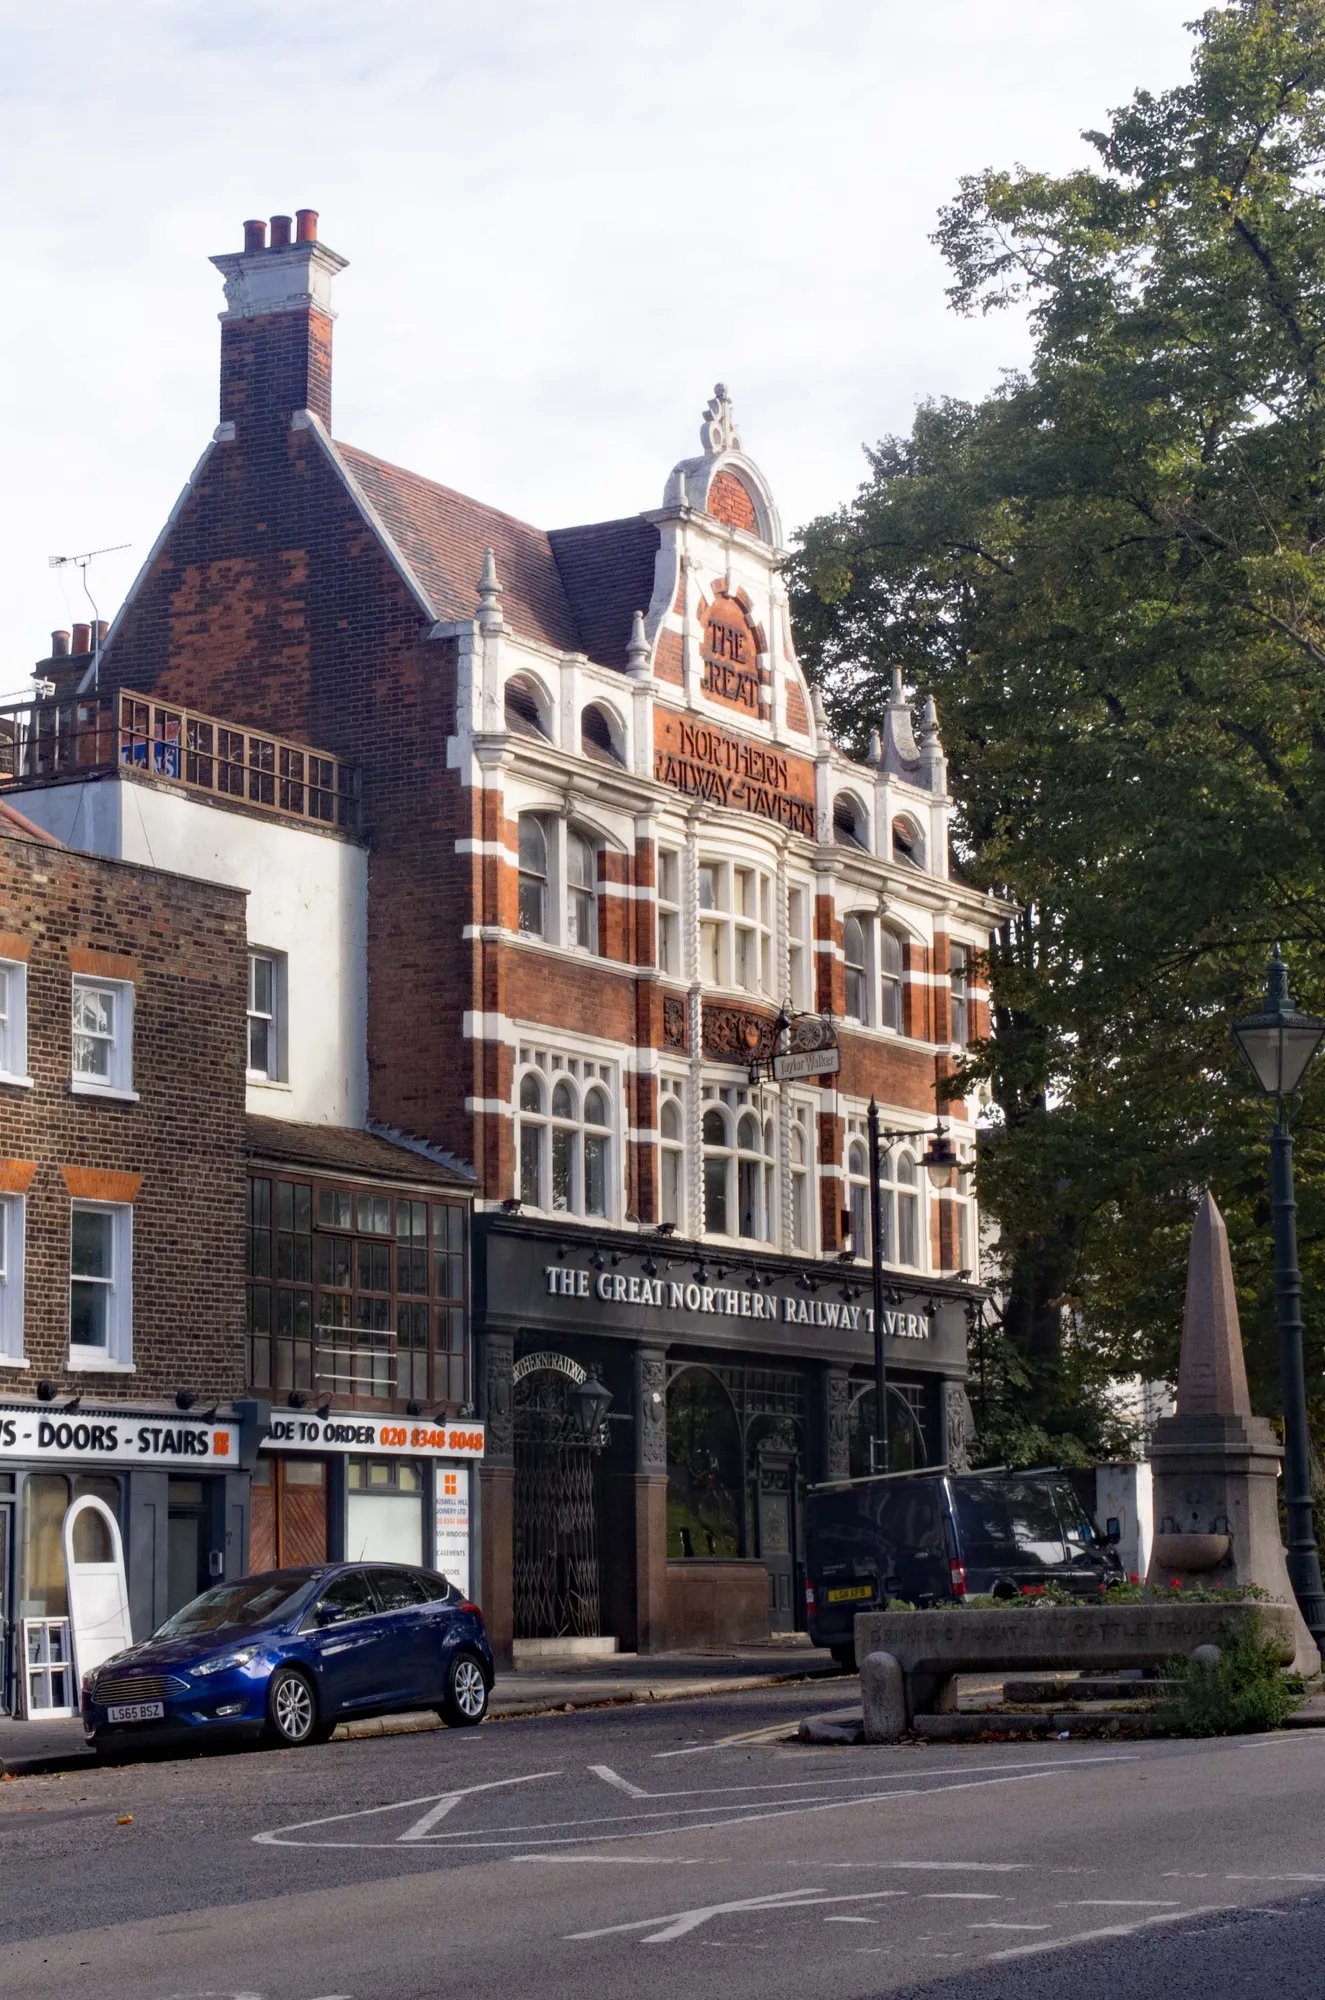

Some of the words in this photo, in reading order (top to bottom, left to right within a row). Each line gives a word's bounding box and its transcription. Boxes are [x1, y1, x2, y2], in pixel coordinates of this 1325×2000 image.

[708, 620, 746, 665] THE
[679, 721, 788, 790] NORTHERN
[779, 1057, 804, 1075] Taylor
[804, 1053, 834, 1072] Walker
[545, 1266, 590, 1297] THE
[597, 1273, 664, 1307] GREAT
[668, 1281, 777, 1320] NORTHERN
[784, 1297, 860, 1331] RAILWAY
[551, 1352, 587, 1385] RAILWA
[0, 1420, 16, 1447] S
[38, 1422, 118, 1451] DOORS
[138, 1427, 209, 1455] STAIRS
[265, 1421, 295, 1441] ADE
[300, 1422, 319, 1442] TO
[323, 1423, 375, 1444] ORDER
[380, 1426, 407, 1446] 020
[411, 1428, 446, 1449] 8348
[449, 1430, 483, 1451] 8048
[446, 1530, 469, 1538] WINDOWS
[437, 1549, 466, 1557] CASEMENTS
[442, 1568, 460, 1576] DOORS
[112, 1707, 138, 1720] LS65
[140, 1705, 160, 1718] BSZ
